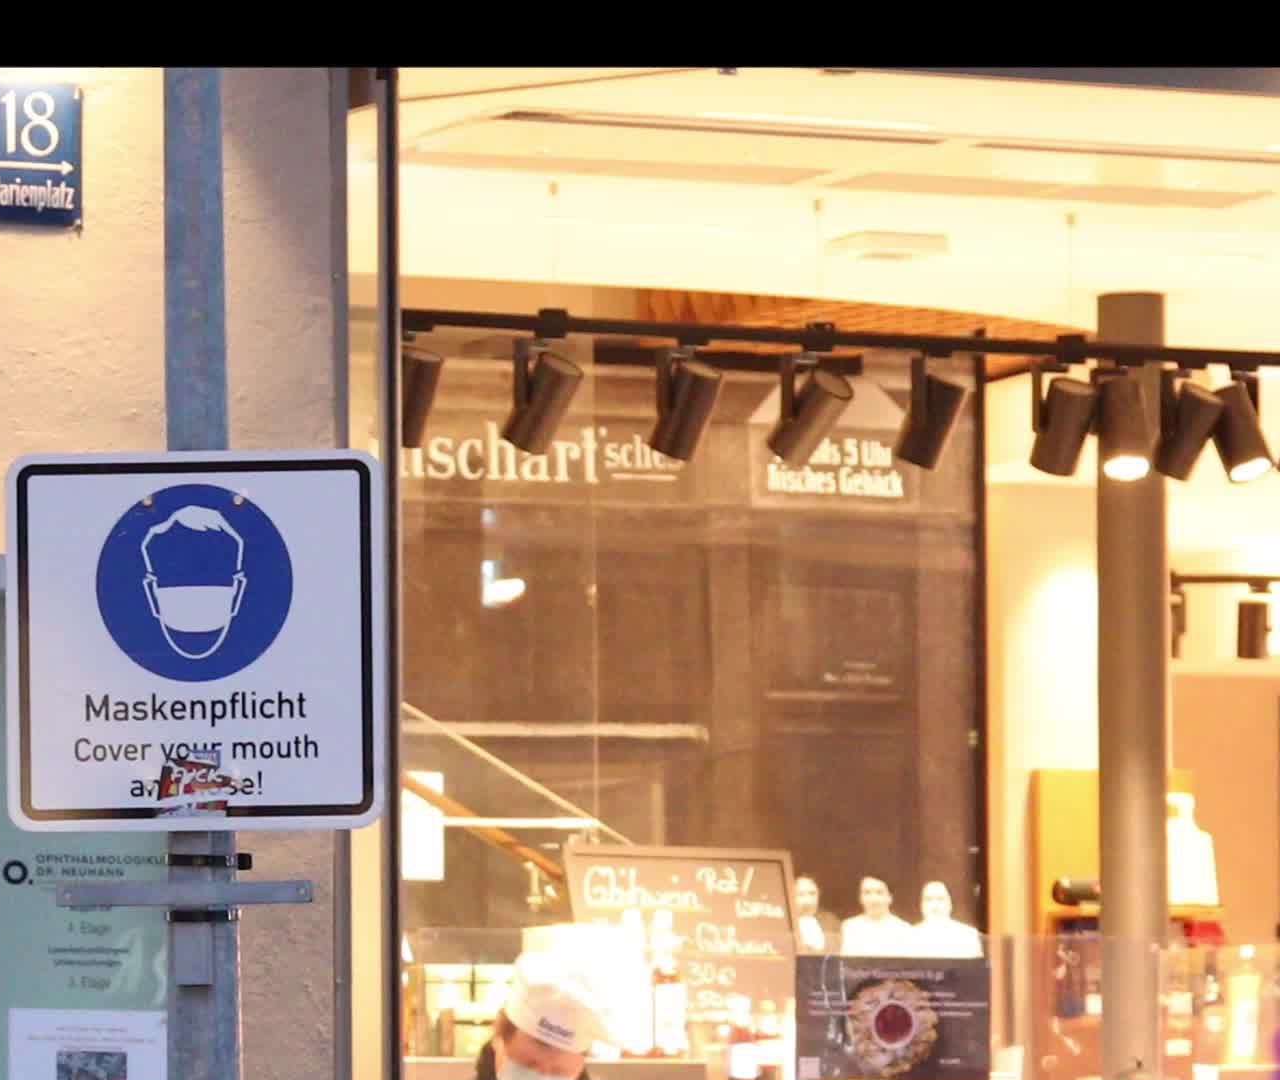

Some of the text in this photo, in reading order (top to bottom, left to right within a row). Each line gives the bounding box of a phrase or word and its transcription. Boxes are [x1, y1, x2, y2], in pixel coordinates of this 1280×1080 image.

[0, 89, 60, 157] 18
[84, 691, 308, 727] Maskenpflicht
[73, 738, 152, 763] Cover
[231, 734, 320, 760] mouth
[35, 853, 164, 866] OPHTHALMOLOGIKU
